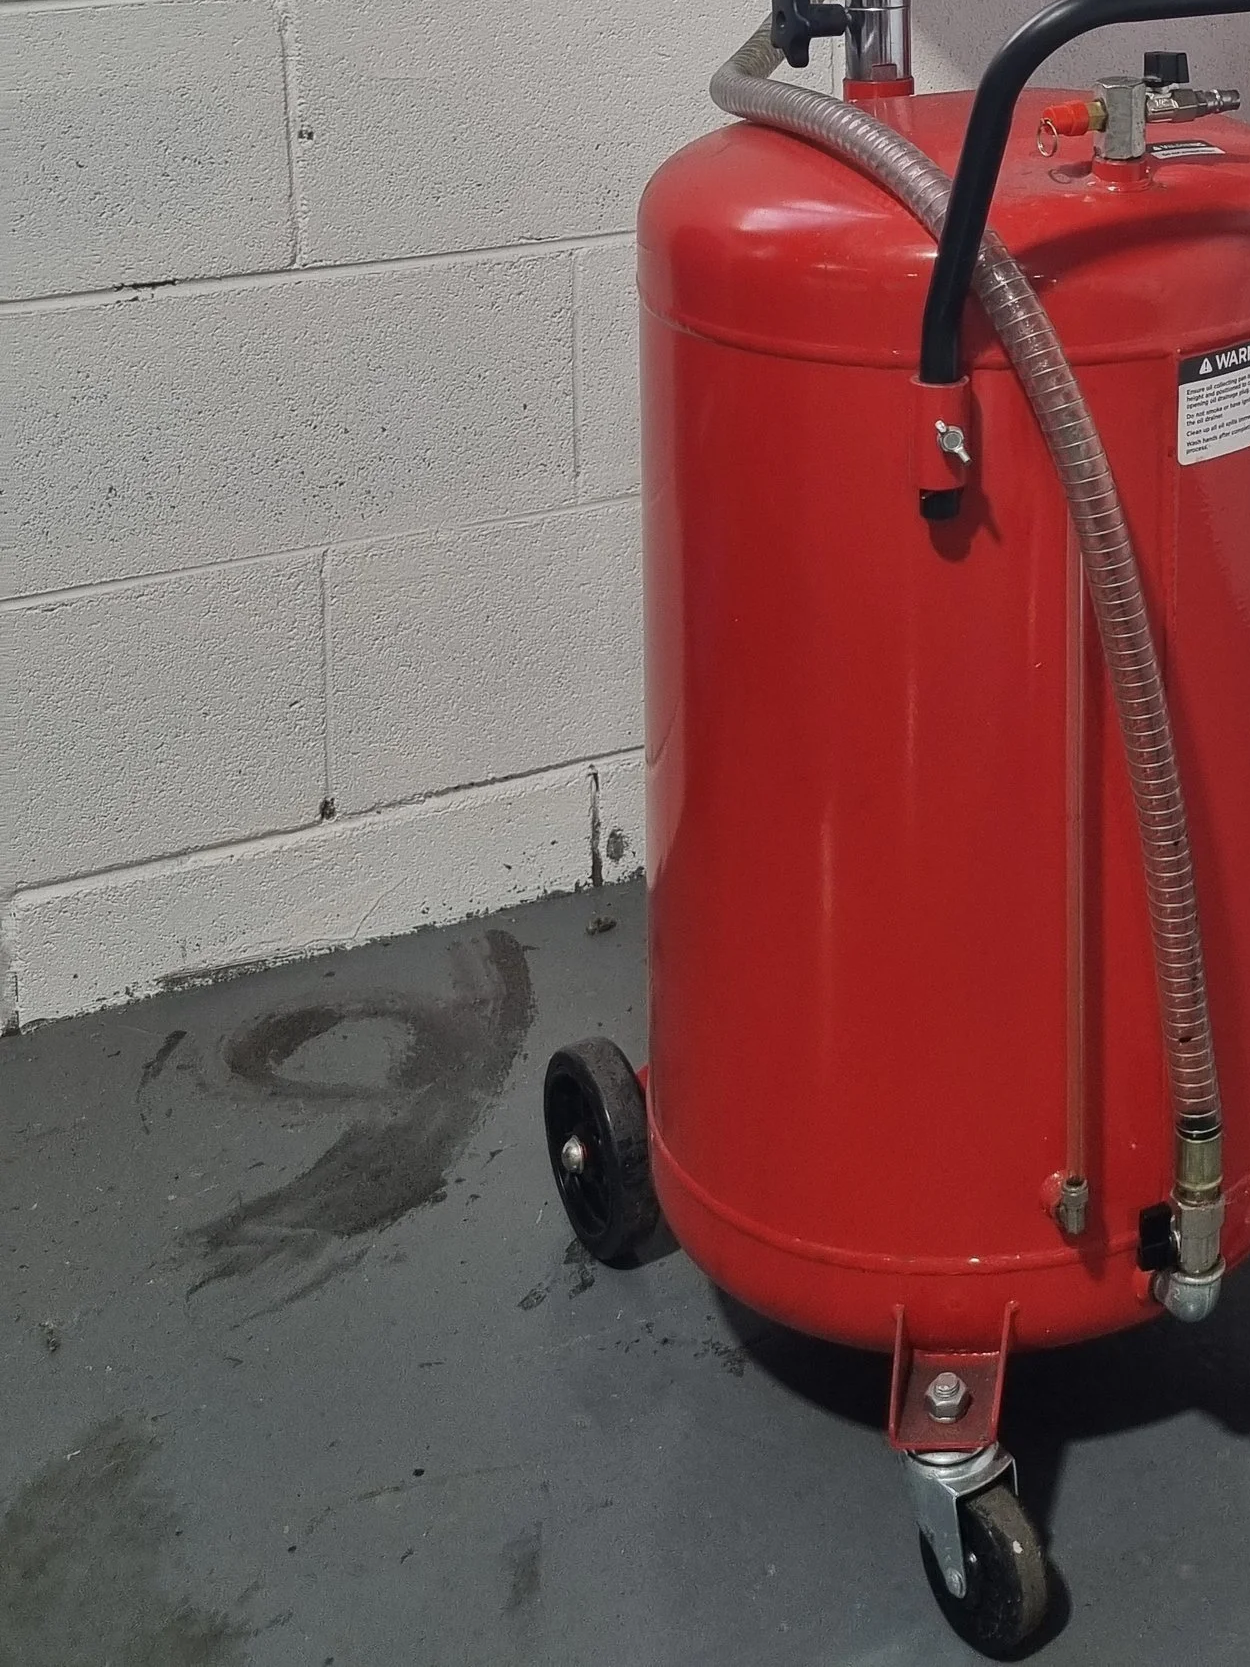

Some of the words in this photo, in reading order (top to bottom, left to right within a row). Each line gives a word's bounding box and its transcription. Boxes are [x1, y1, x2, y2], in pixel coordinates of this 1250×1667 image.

[1187, 387, 1205, 395] Ensure
[1214, 378, 1237, 389] collecting
[1216, 384, 1241, 396] positioned
[1187, 400, 1208, 410] opening
[1218, 392, 1238, 402] drainage
[1206, 406, 1222, 414] smoke
[1186, 428, 1202, 436] Clean
[1202, 435, 1218, 443] hands
[1219, 431, 1230, 439] after
